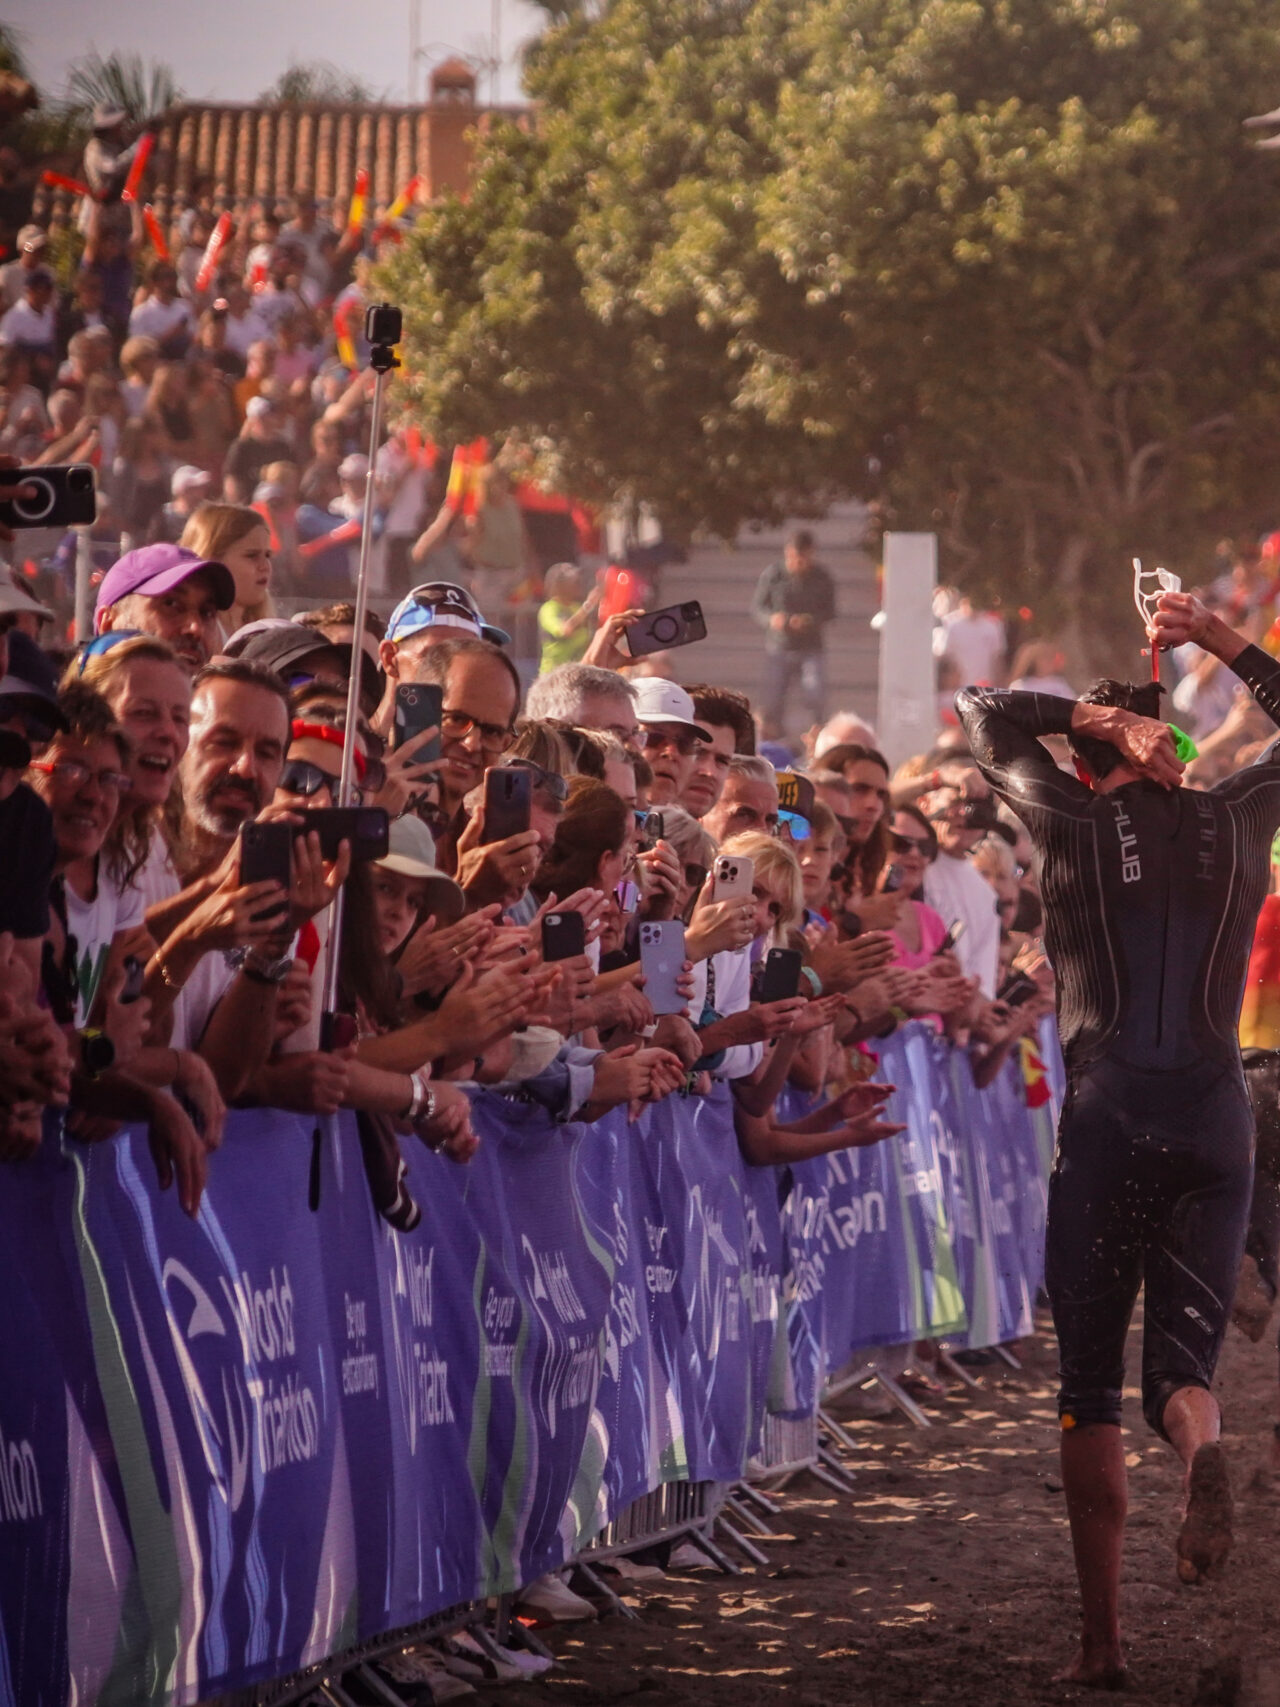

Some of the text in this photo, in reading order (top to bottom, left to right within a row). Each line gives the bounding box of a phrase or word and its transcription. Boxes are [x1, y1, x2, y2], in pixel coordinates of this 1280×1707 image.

[1111, 801, 1141, 884] HUUB
[218, 1264, 296, 1363] World
[247, 1372, 318, 1475] Triathlon
